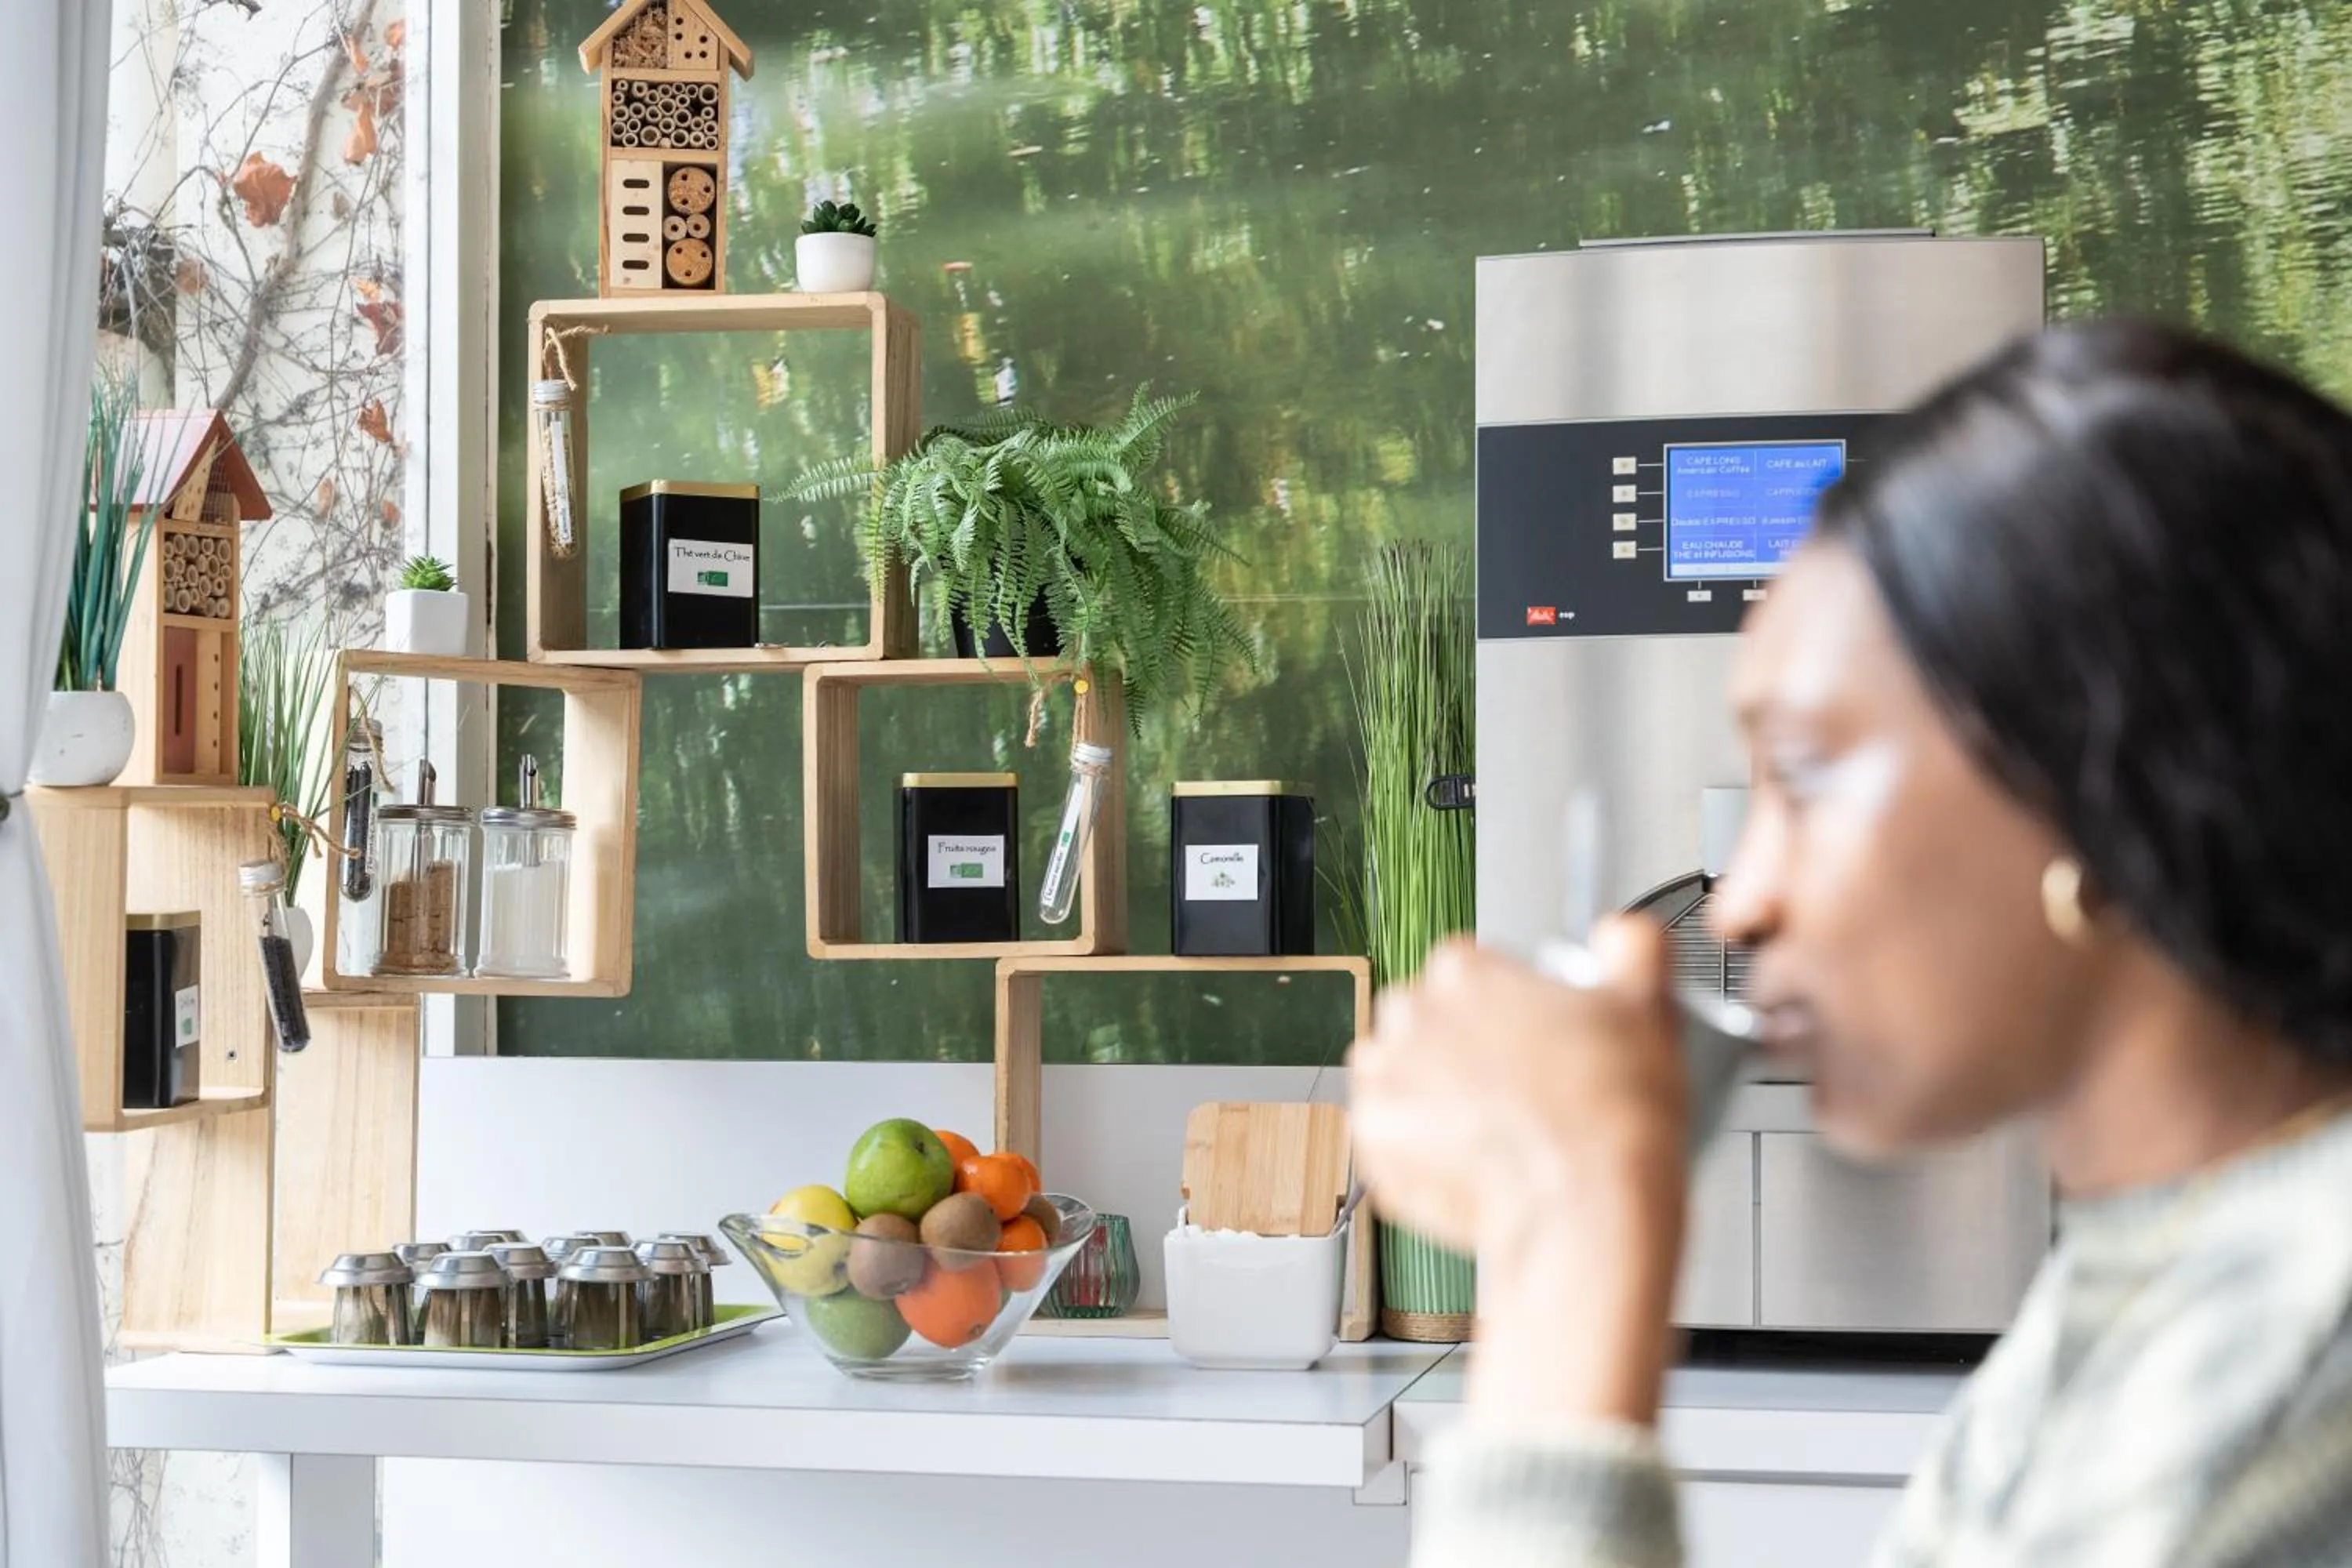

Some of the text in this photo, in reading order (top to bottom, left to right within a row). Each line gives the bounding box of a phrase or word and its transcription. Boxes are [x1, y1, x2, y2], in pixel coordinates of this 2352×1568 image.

[1766, 459, 1792, 469] CAFE
[1806, 457, 1827, 468] LAIT
[1682, 539, 1744, 550] EAU CHAUDE
